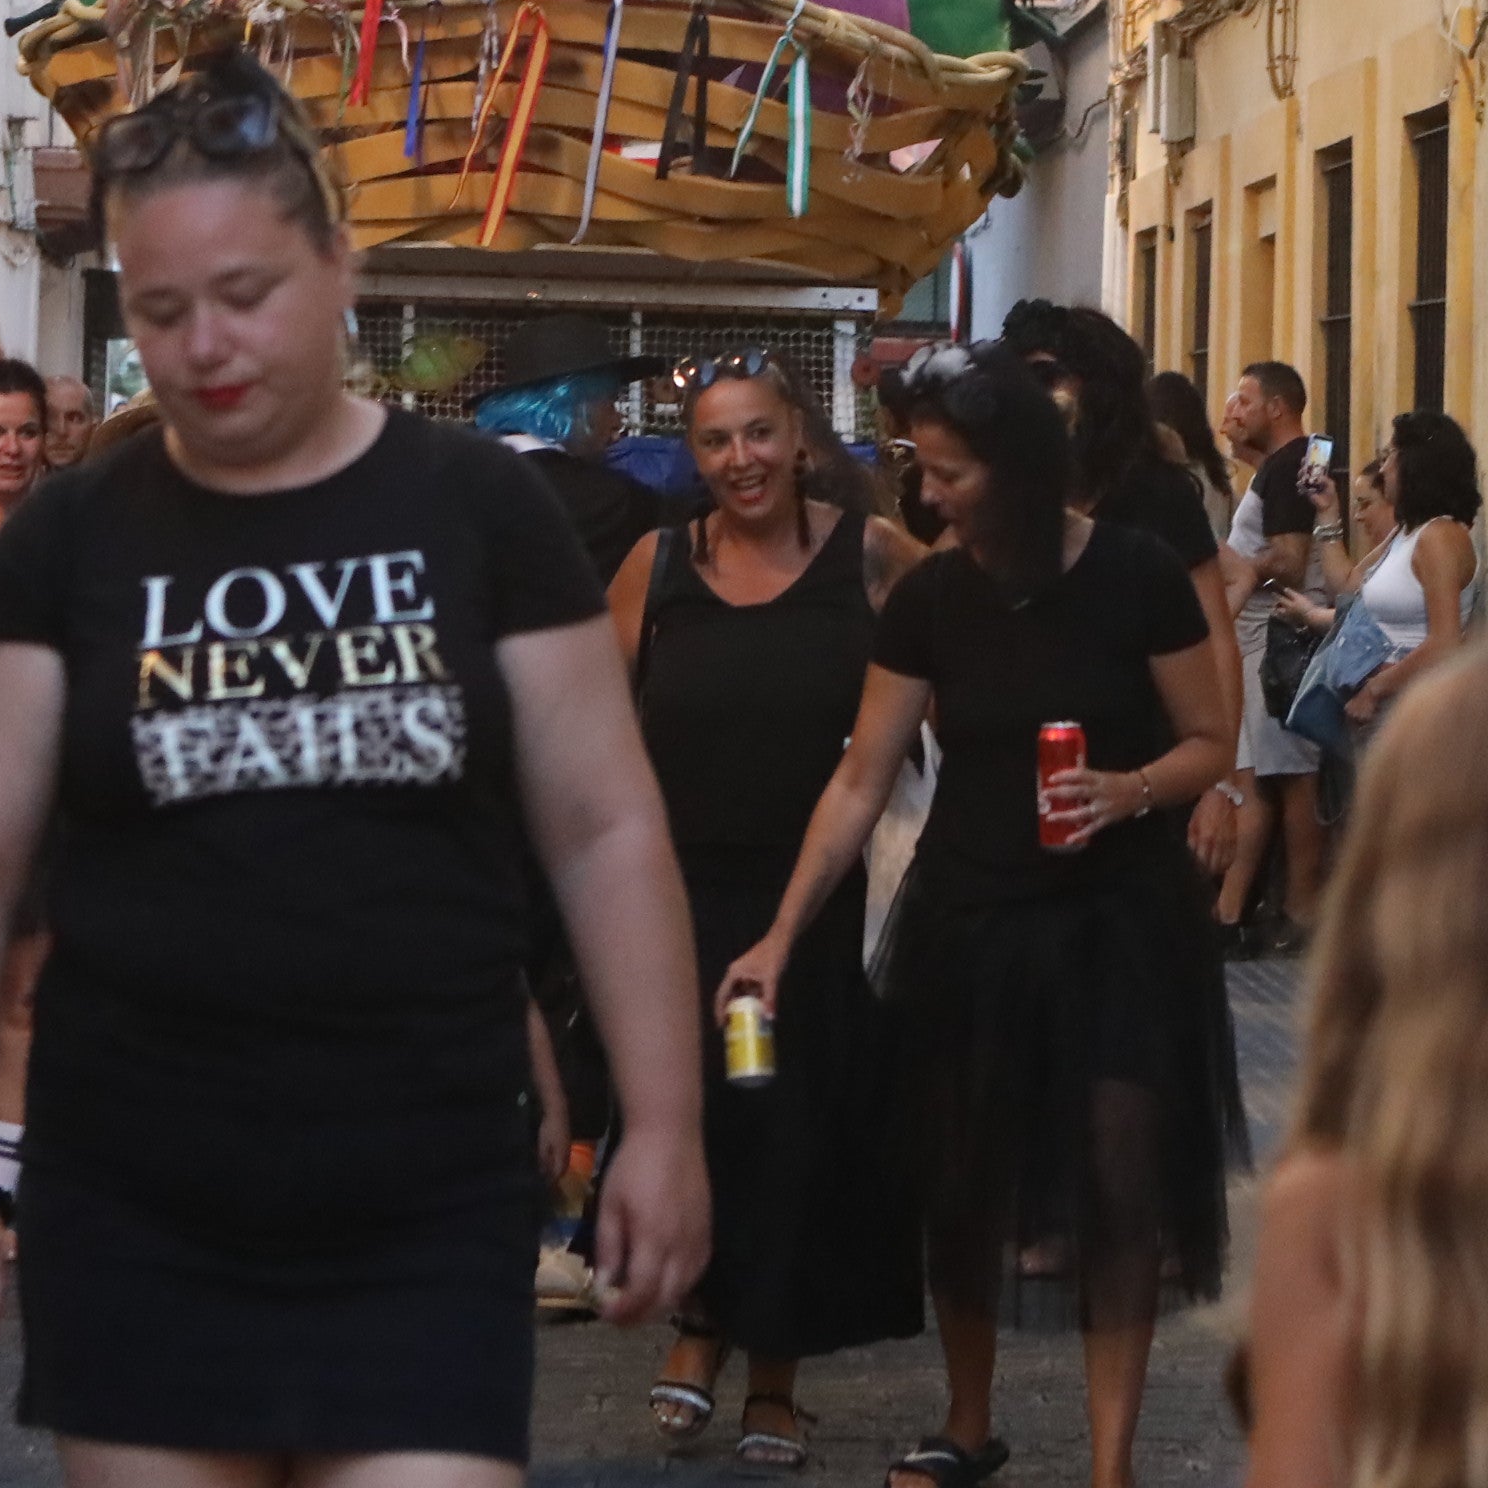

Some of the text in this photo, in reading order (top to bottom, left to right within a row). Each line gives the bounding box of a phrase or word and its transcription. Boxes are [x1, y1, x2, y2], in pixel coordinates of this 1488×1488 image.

[140, 549, 436, 650] LOVE
[136, 623, 454, 712] NEVER
[156, 696, 455, 798] FAILS
